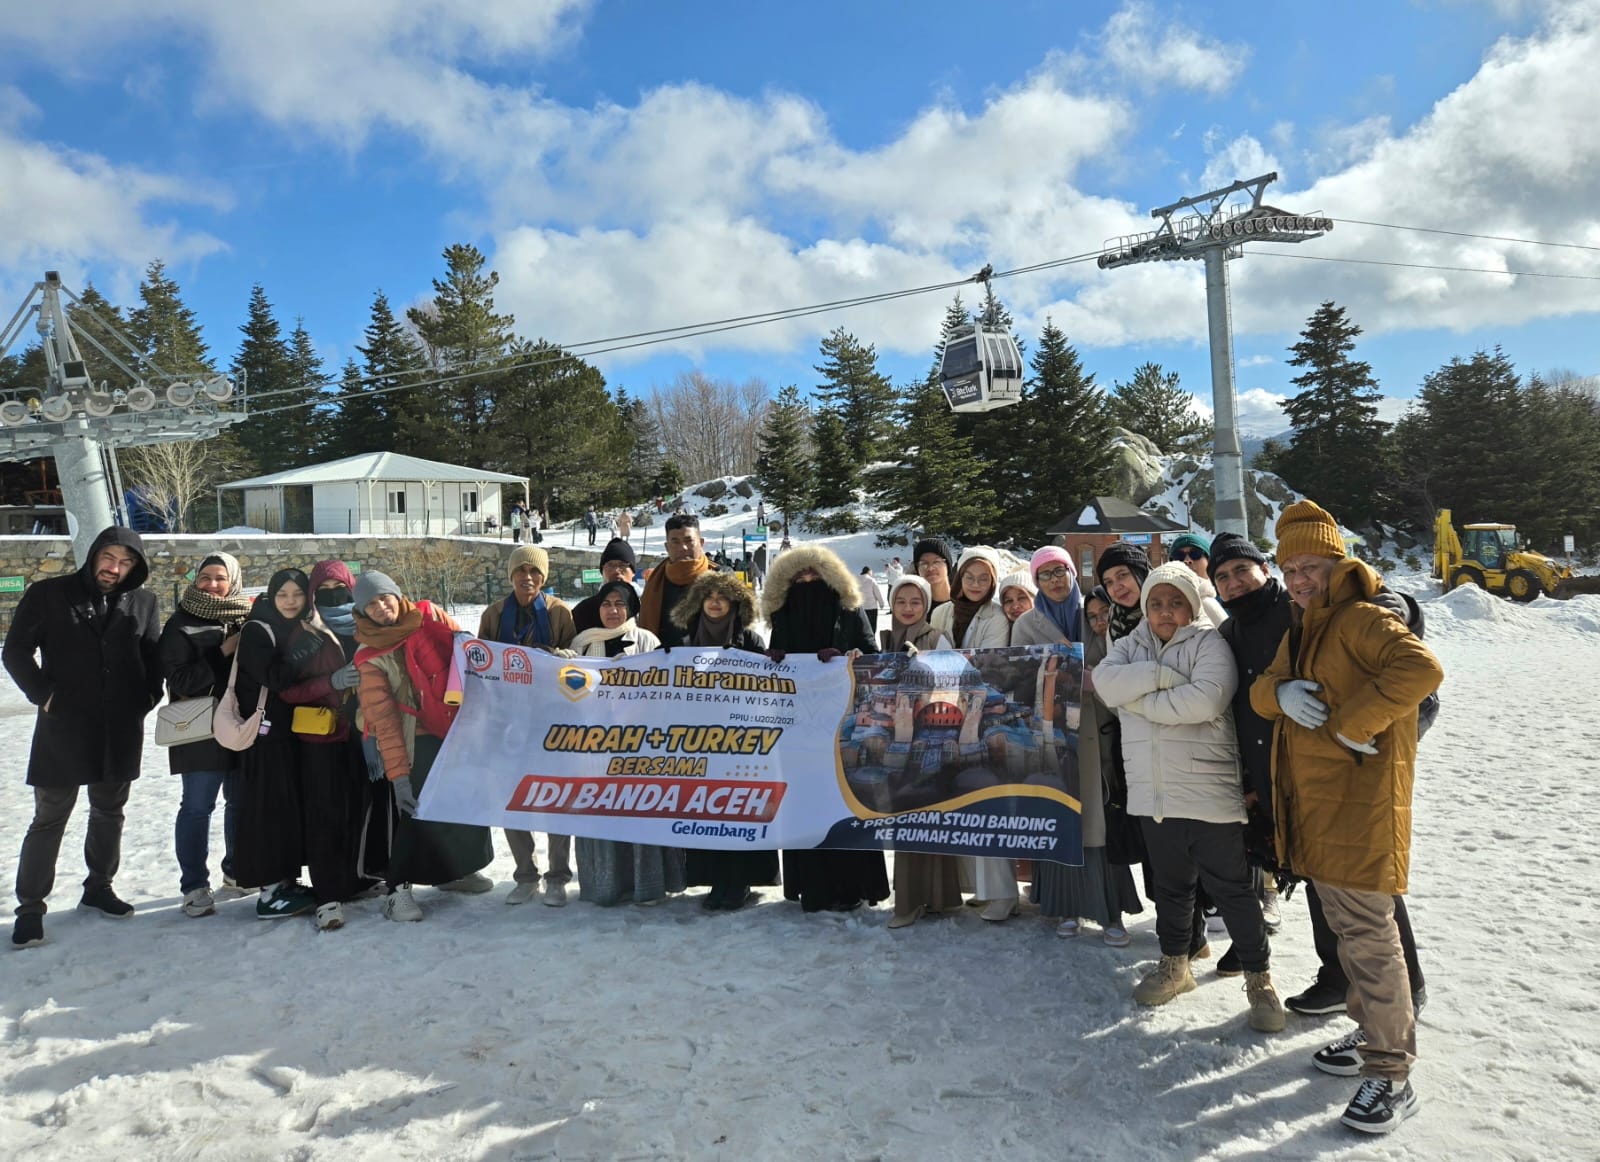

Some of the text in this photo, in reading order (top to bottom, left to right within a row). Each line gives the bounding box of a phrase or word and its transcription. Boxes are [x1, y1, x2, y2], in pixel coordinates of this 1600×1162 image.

[692, 655, 760, 669] Cooperation
[763, 661, 790, 672] With
[503, 671, 532, 685] KOPIDI
[673, 664, 797, 694] Haramain
[597, 690, 795, 708] PT. ALJAZIRA BERKAH WISATA
[729, 713, 750, 723] PPIU
[606, 756, 709, 777] BERSAMA
[522, 781, 774, 816] IDI BANDA ACEH
[671, 820, 768, 842] Gelombang I
[863, 812, 941, 829] PROGRAM
[942, 812, 985, 829] STUDI
[987, 815, 1057, 832] BANDING
[874, 828, 1059, 850] KE RUMAH SAKIT TURKEY
